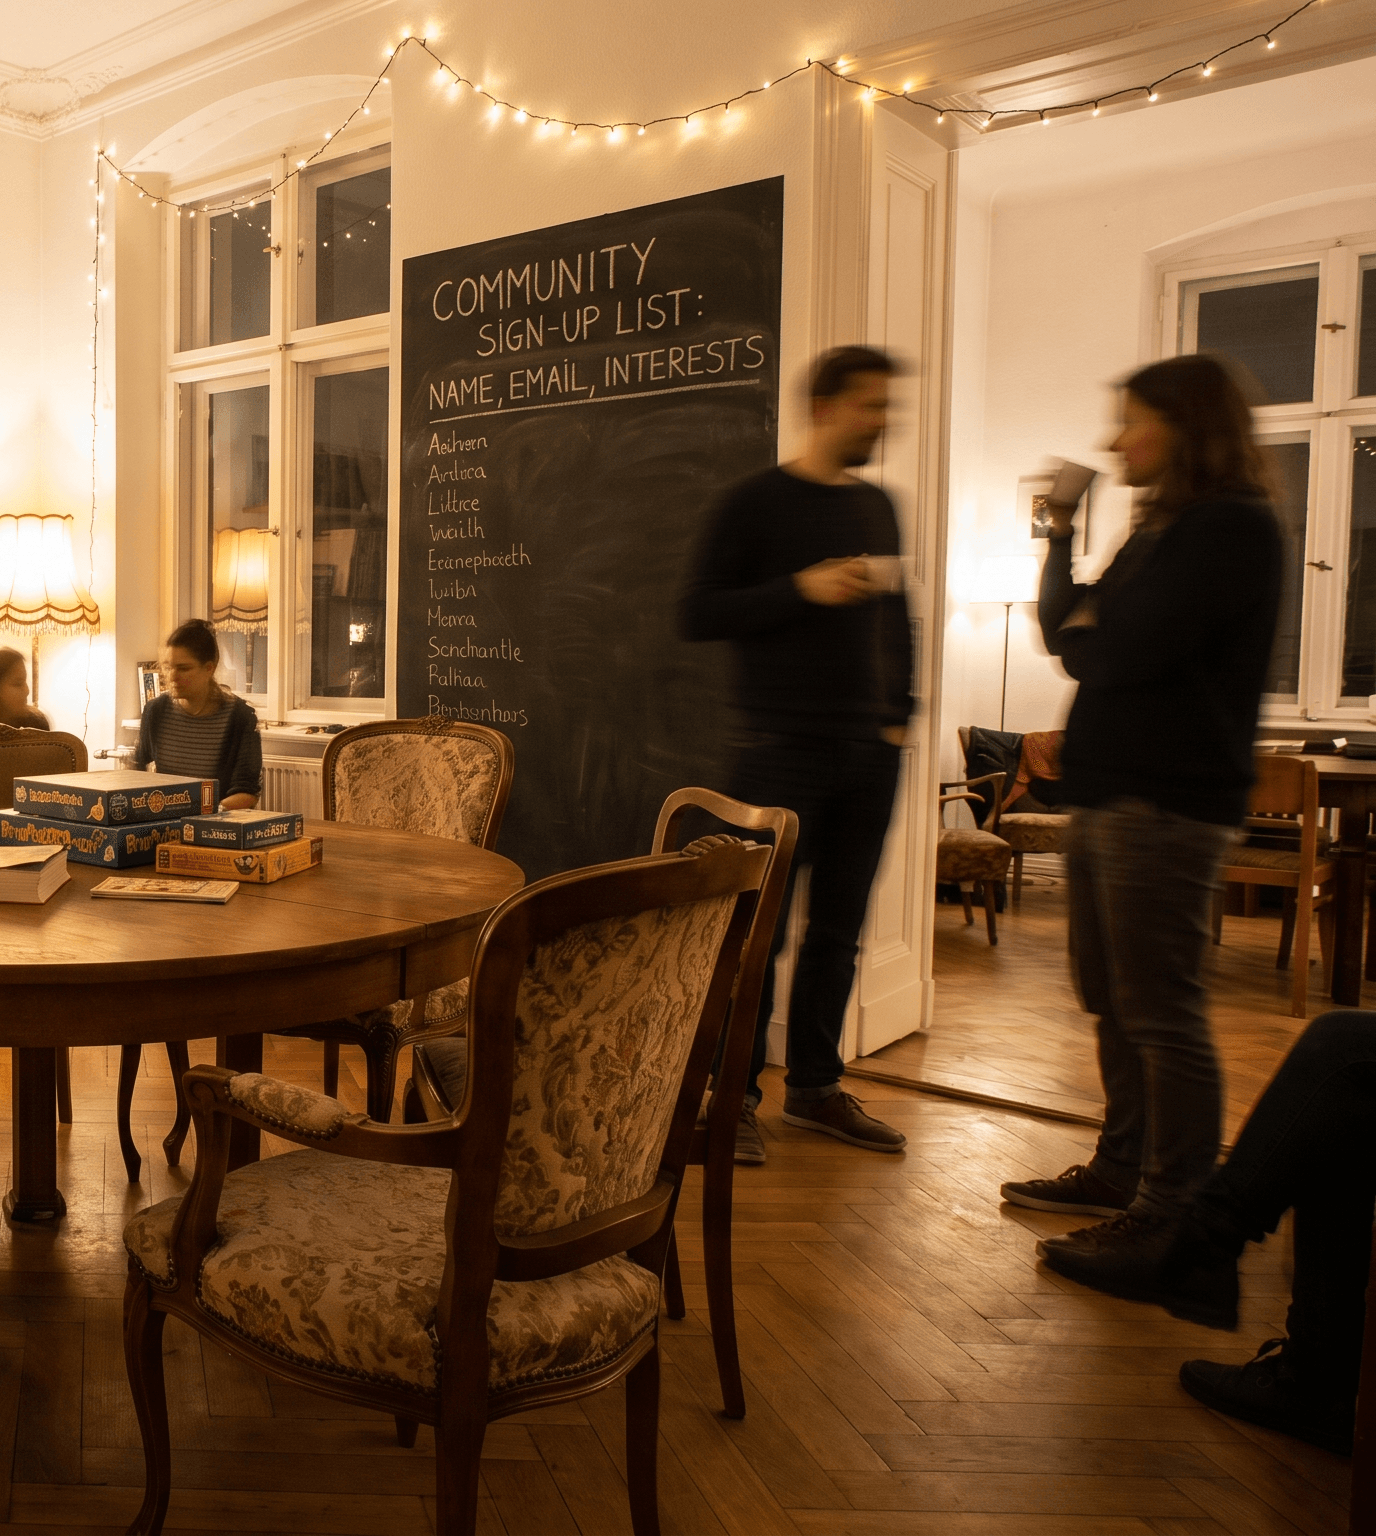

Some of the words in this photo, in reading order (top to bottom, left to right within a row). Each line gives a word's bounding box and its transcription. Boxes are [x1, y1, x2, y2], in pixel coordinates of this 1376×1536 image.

[432, 237, 656, 321] COMMUNITY
[616, 287, 703, 335] LIST:
[428, 373, 503, 411] NAME,
[509, 358, 595, 399] EMAIL,
[604, 335, 765, 388] INTERESTS
